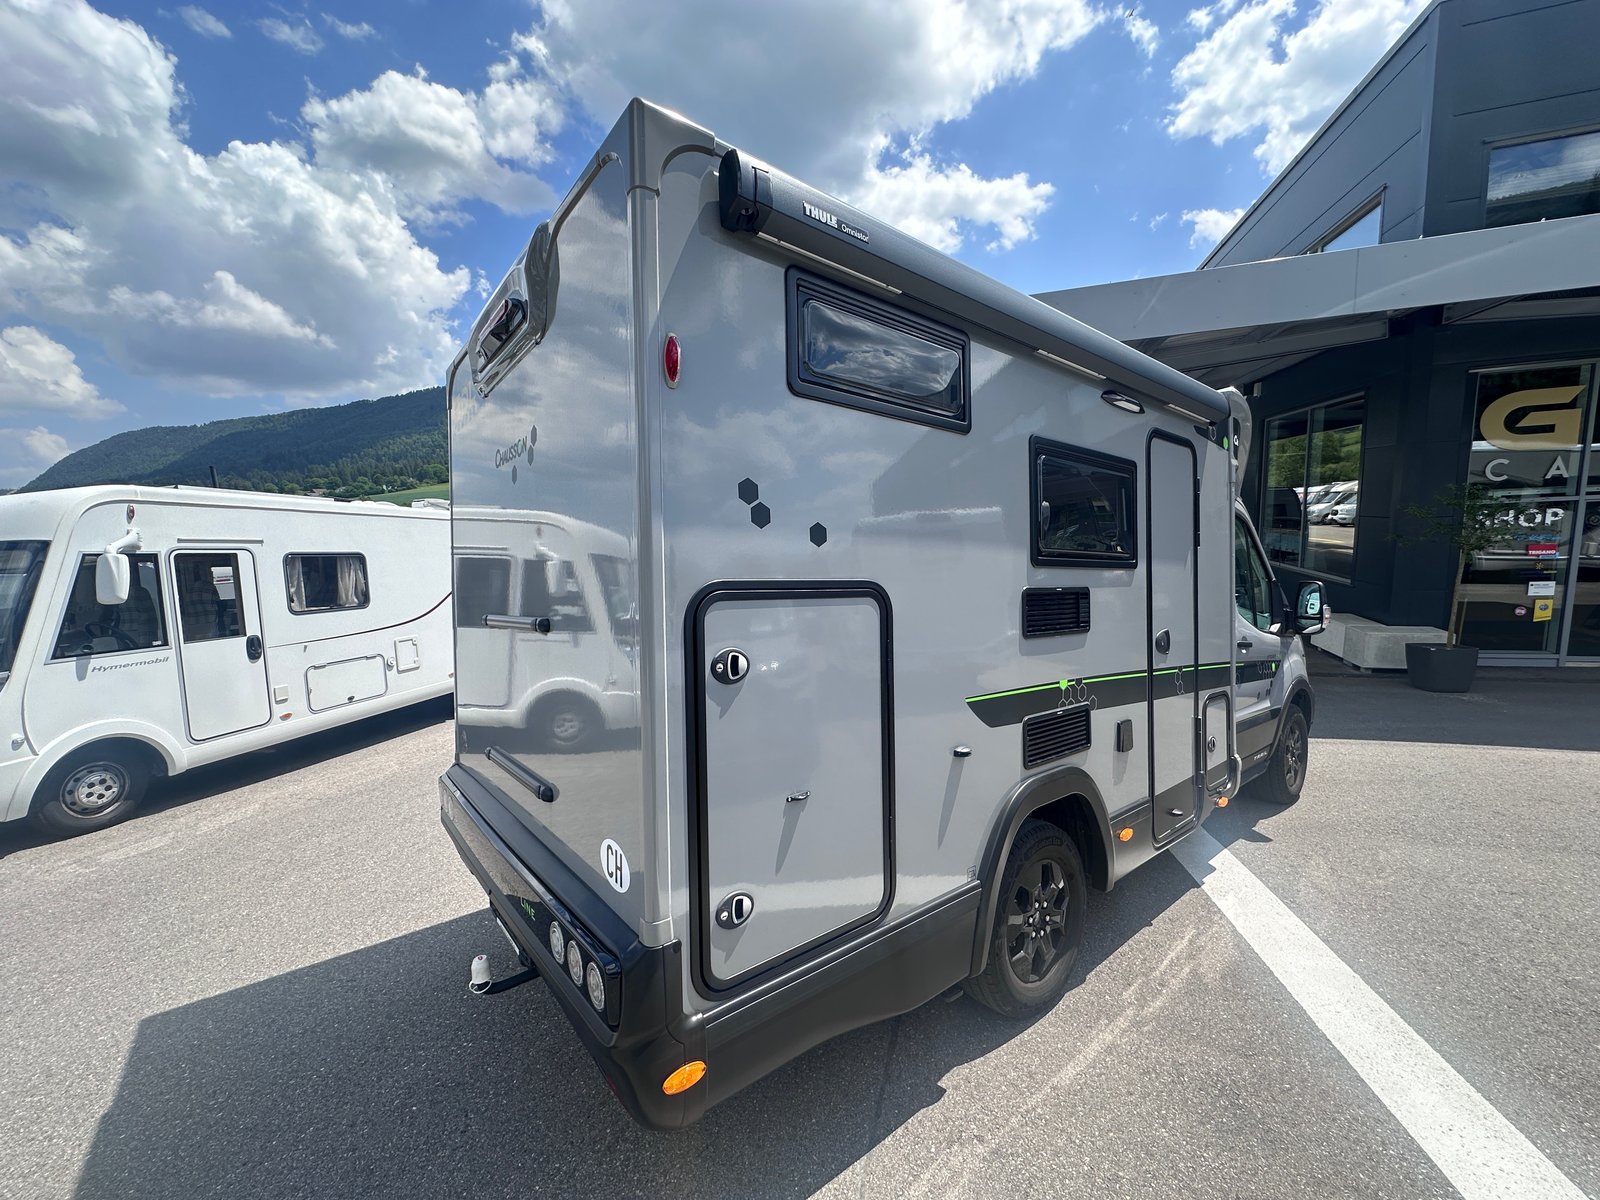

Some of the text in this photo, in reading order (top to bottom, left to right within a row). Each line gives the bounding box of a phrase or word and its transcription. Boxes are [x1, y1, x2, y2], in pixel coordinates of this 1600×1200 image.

[802, 200, 869, 242] THULE Omnistor
[1480, 385, 1586, 451] G
[91, 656, 170, 673] Hymermobil
[606, 843, 623, 889] CH
